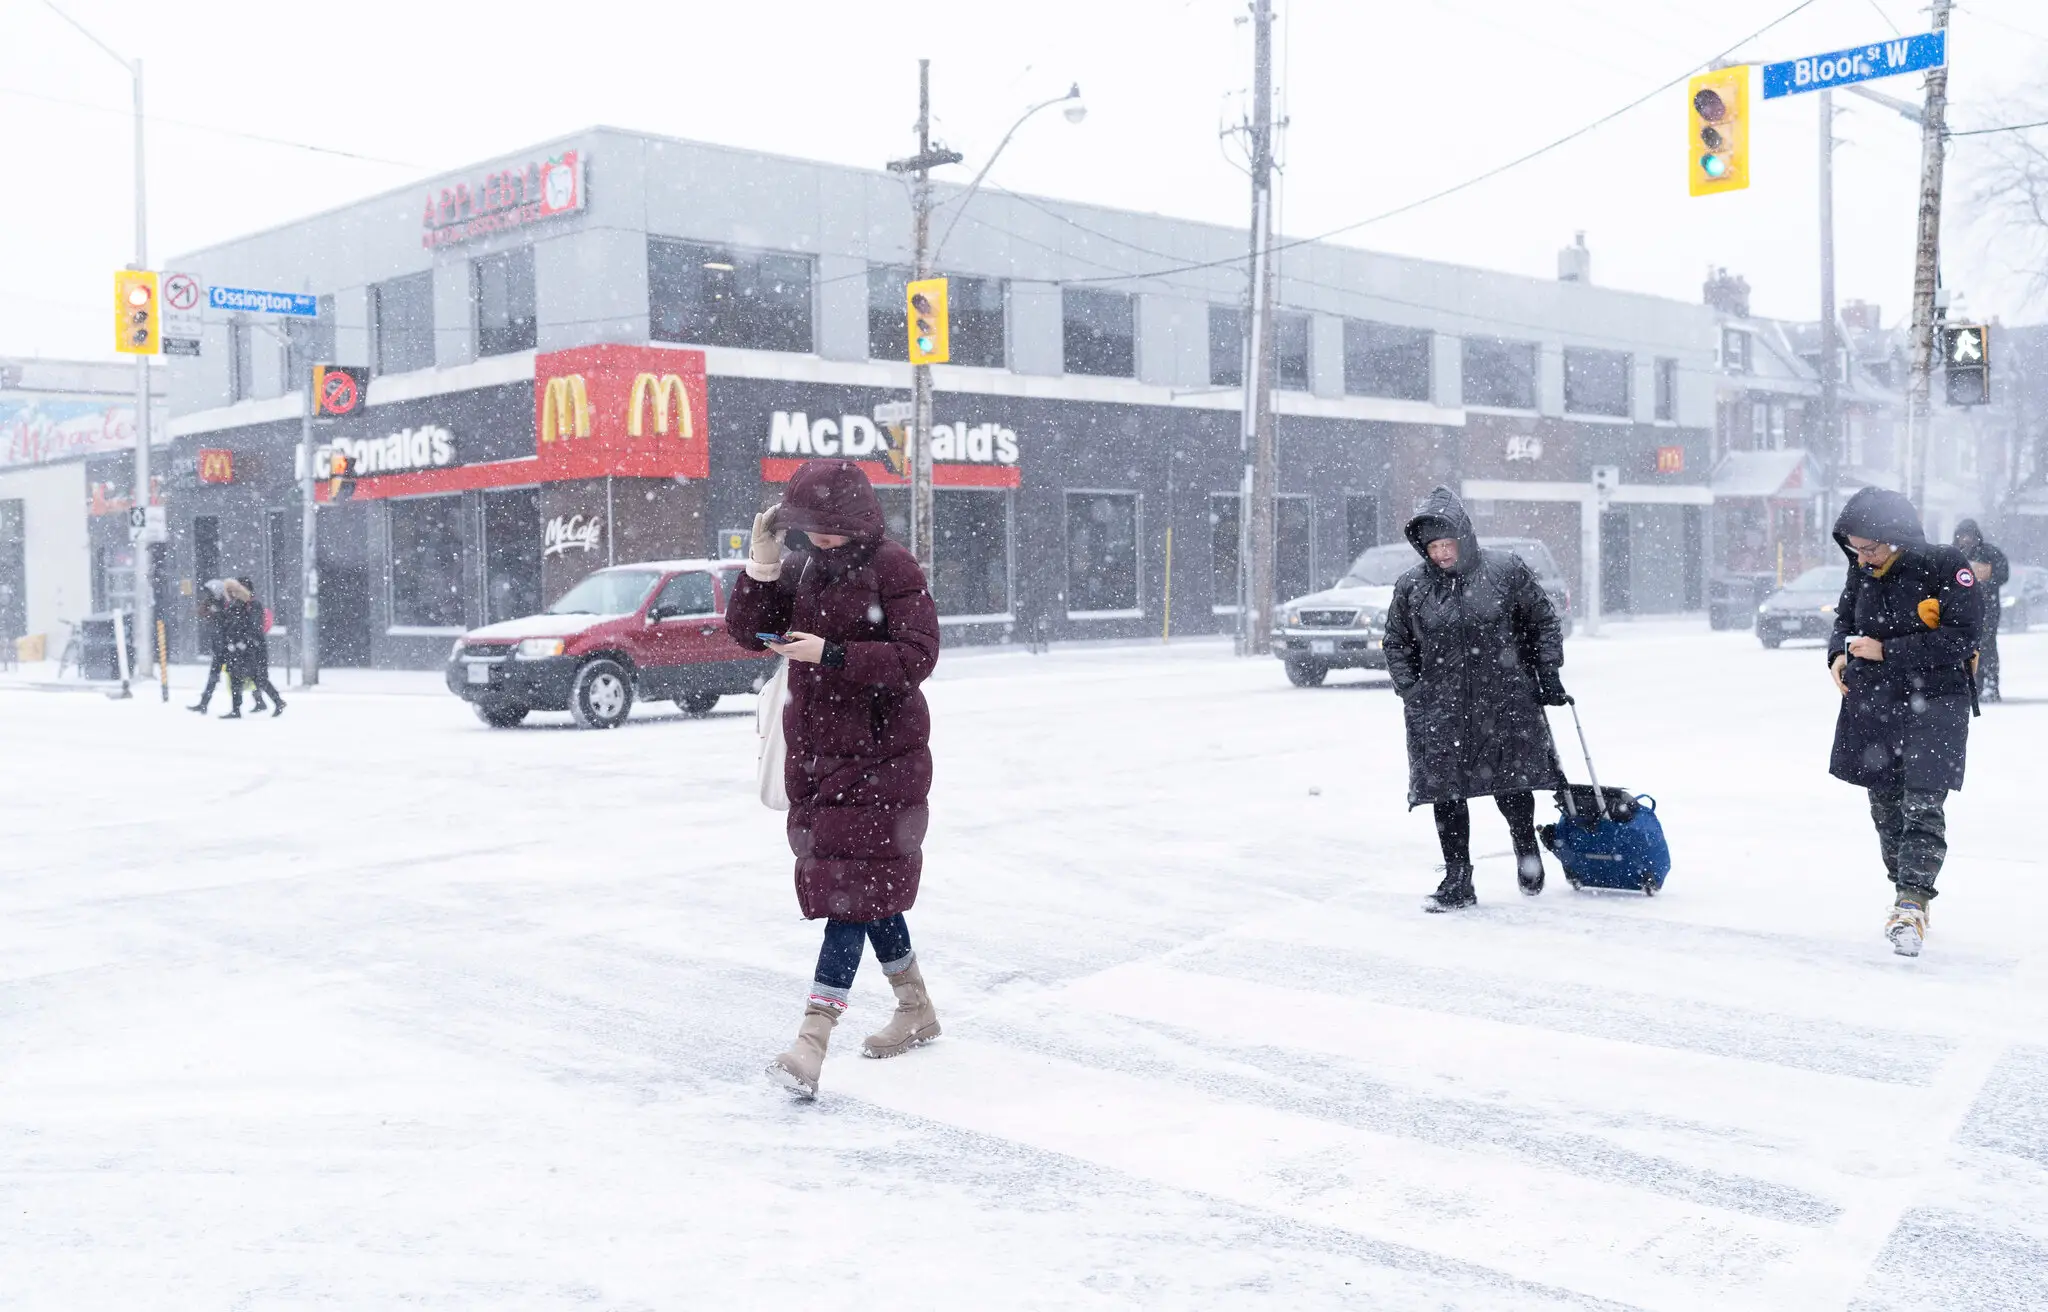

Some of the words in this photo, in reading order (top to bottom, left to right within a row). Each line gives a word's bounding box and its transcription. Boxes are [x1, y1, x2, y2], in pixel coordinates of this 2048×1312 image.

[1795, 54, 1862, 86] Bloor
[1867, 47, 1880, 60] St
[1886, 40, 1908, 68] W
[423, 163, 533, 228] APPLEBY
[213, 288, 292, 312] Ossington
